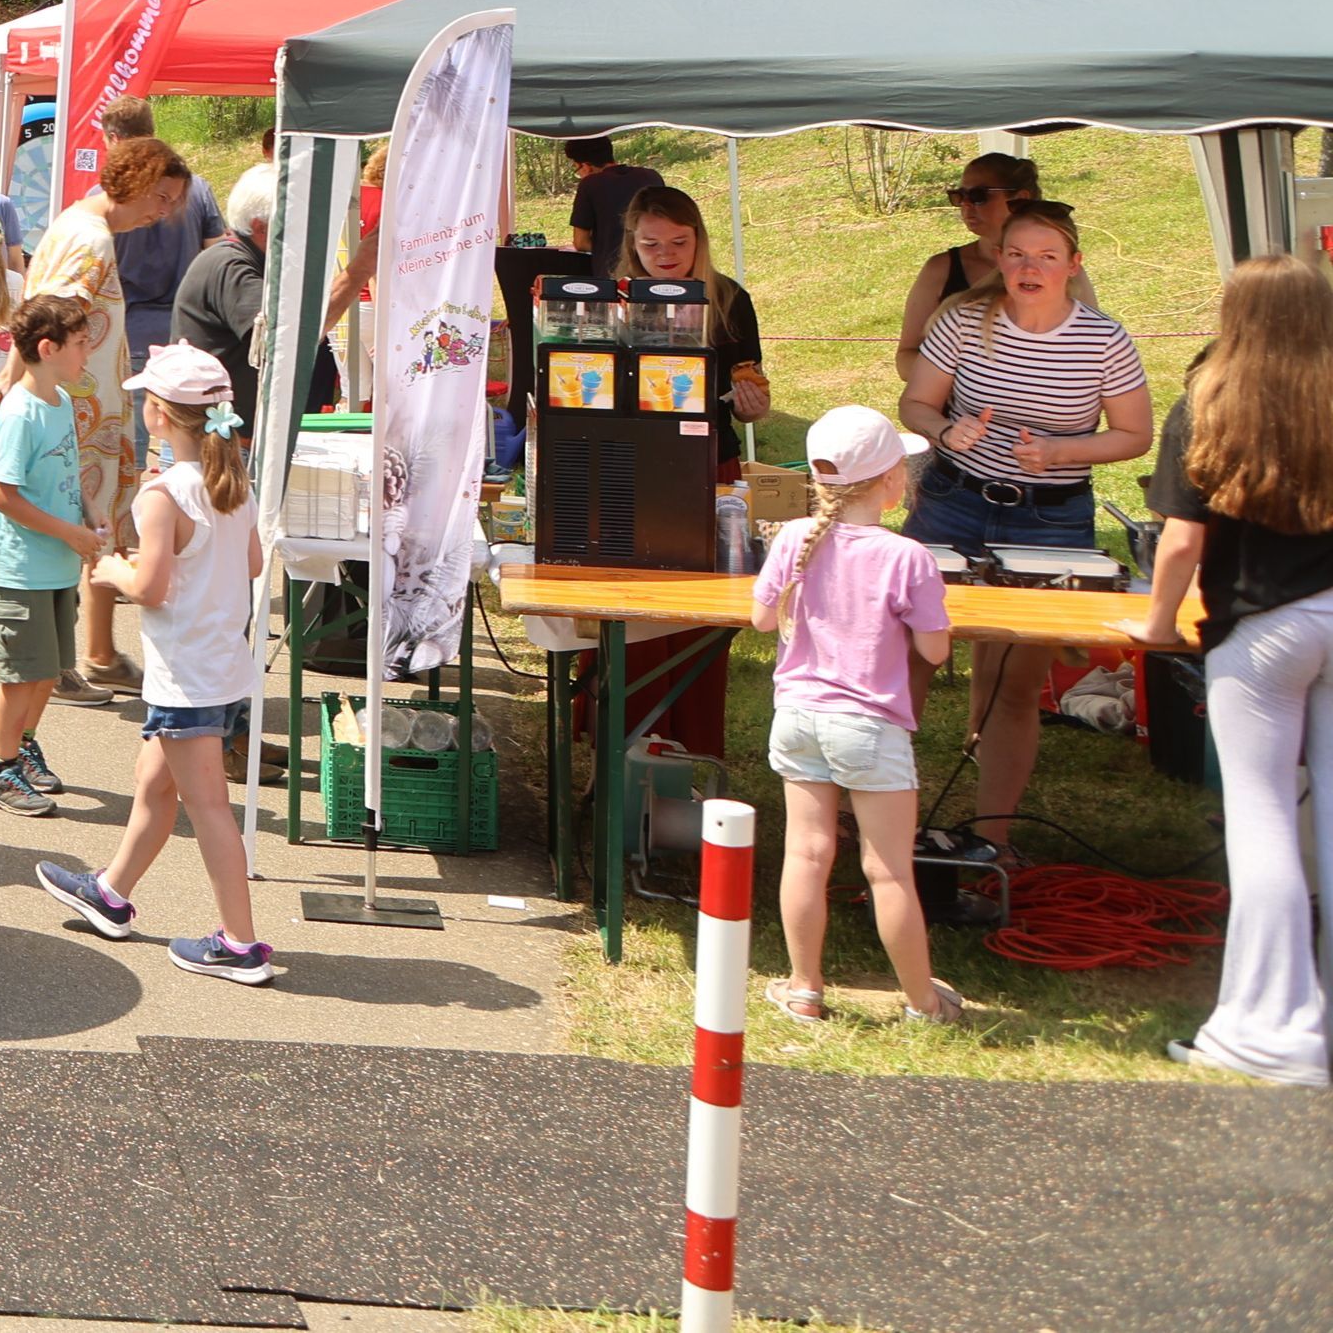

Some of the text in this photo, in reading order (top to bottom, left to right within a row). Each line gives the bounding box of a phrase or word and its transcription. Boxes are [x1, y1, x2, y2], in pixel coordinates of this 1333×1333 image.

[24, 128, 32, 139] 5
[42, 122, 55, 134] 20
[397, 256, 432, 277] Kleine
